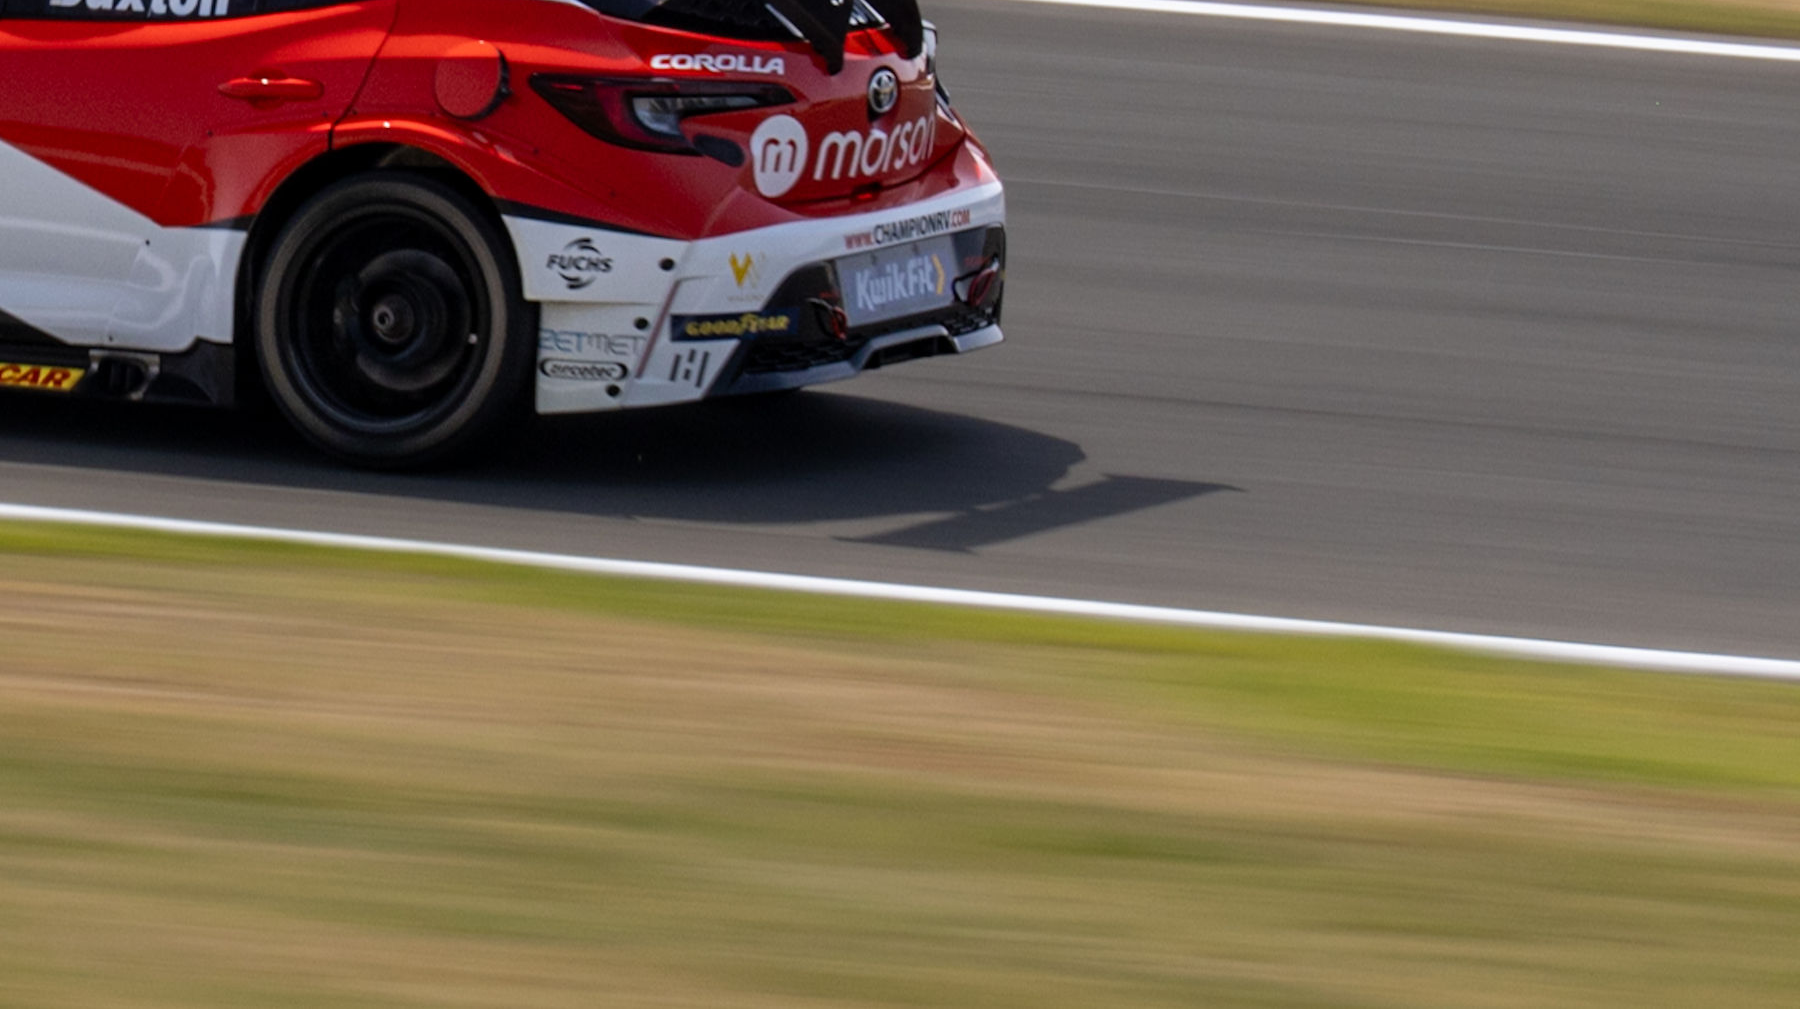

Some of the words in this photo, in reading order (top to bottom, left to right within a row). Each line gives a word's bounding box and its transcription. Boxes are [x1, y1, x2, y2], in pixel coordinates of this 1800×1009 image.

[650, 53, 786, 76] COROLLA
[813, 110, 937, 181] morson
[546, 253, 615, 273] FUCHS
